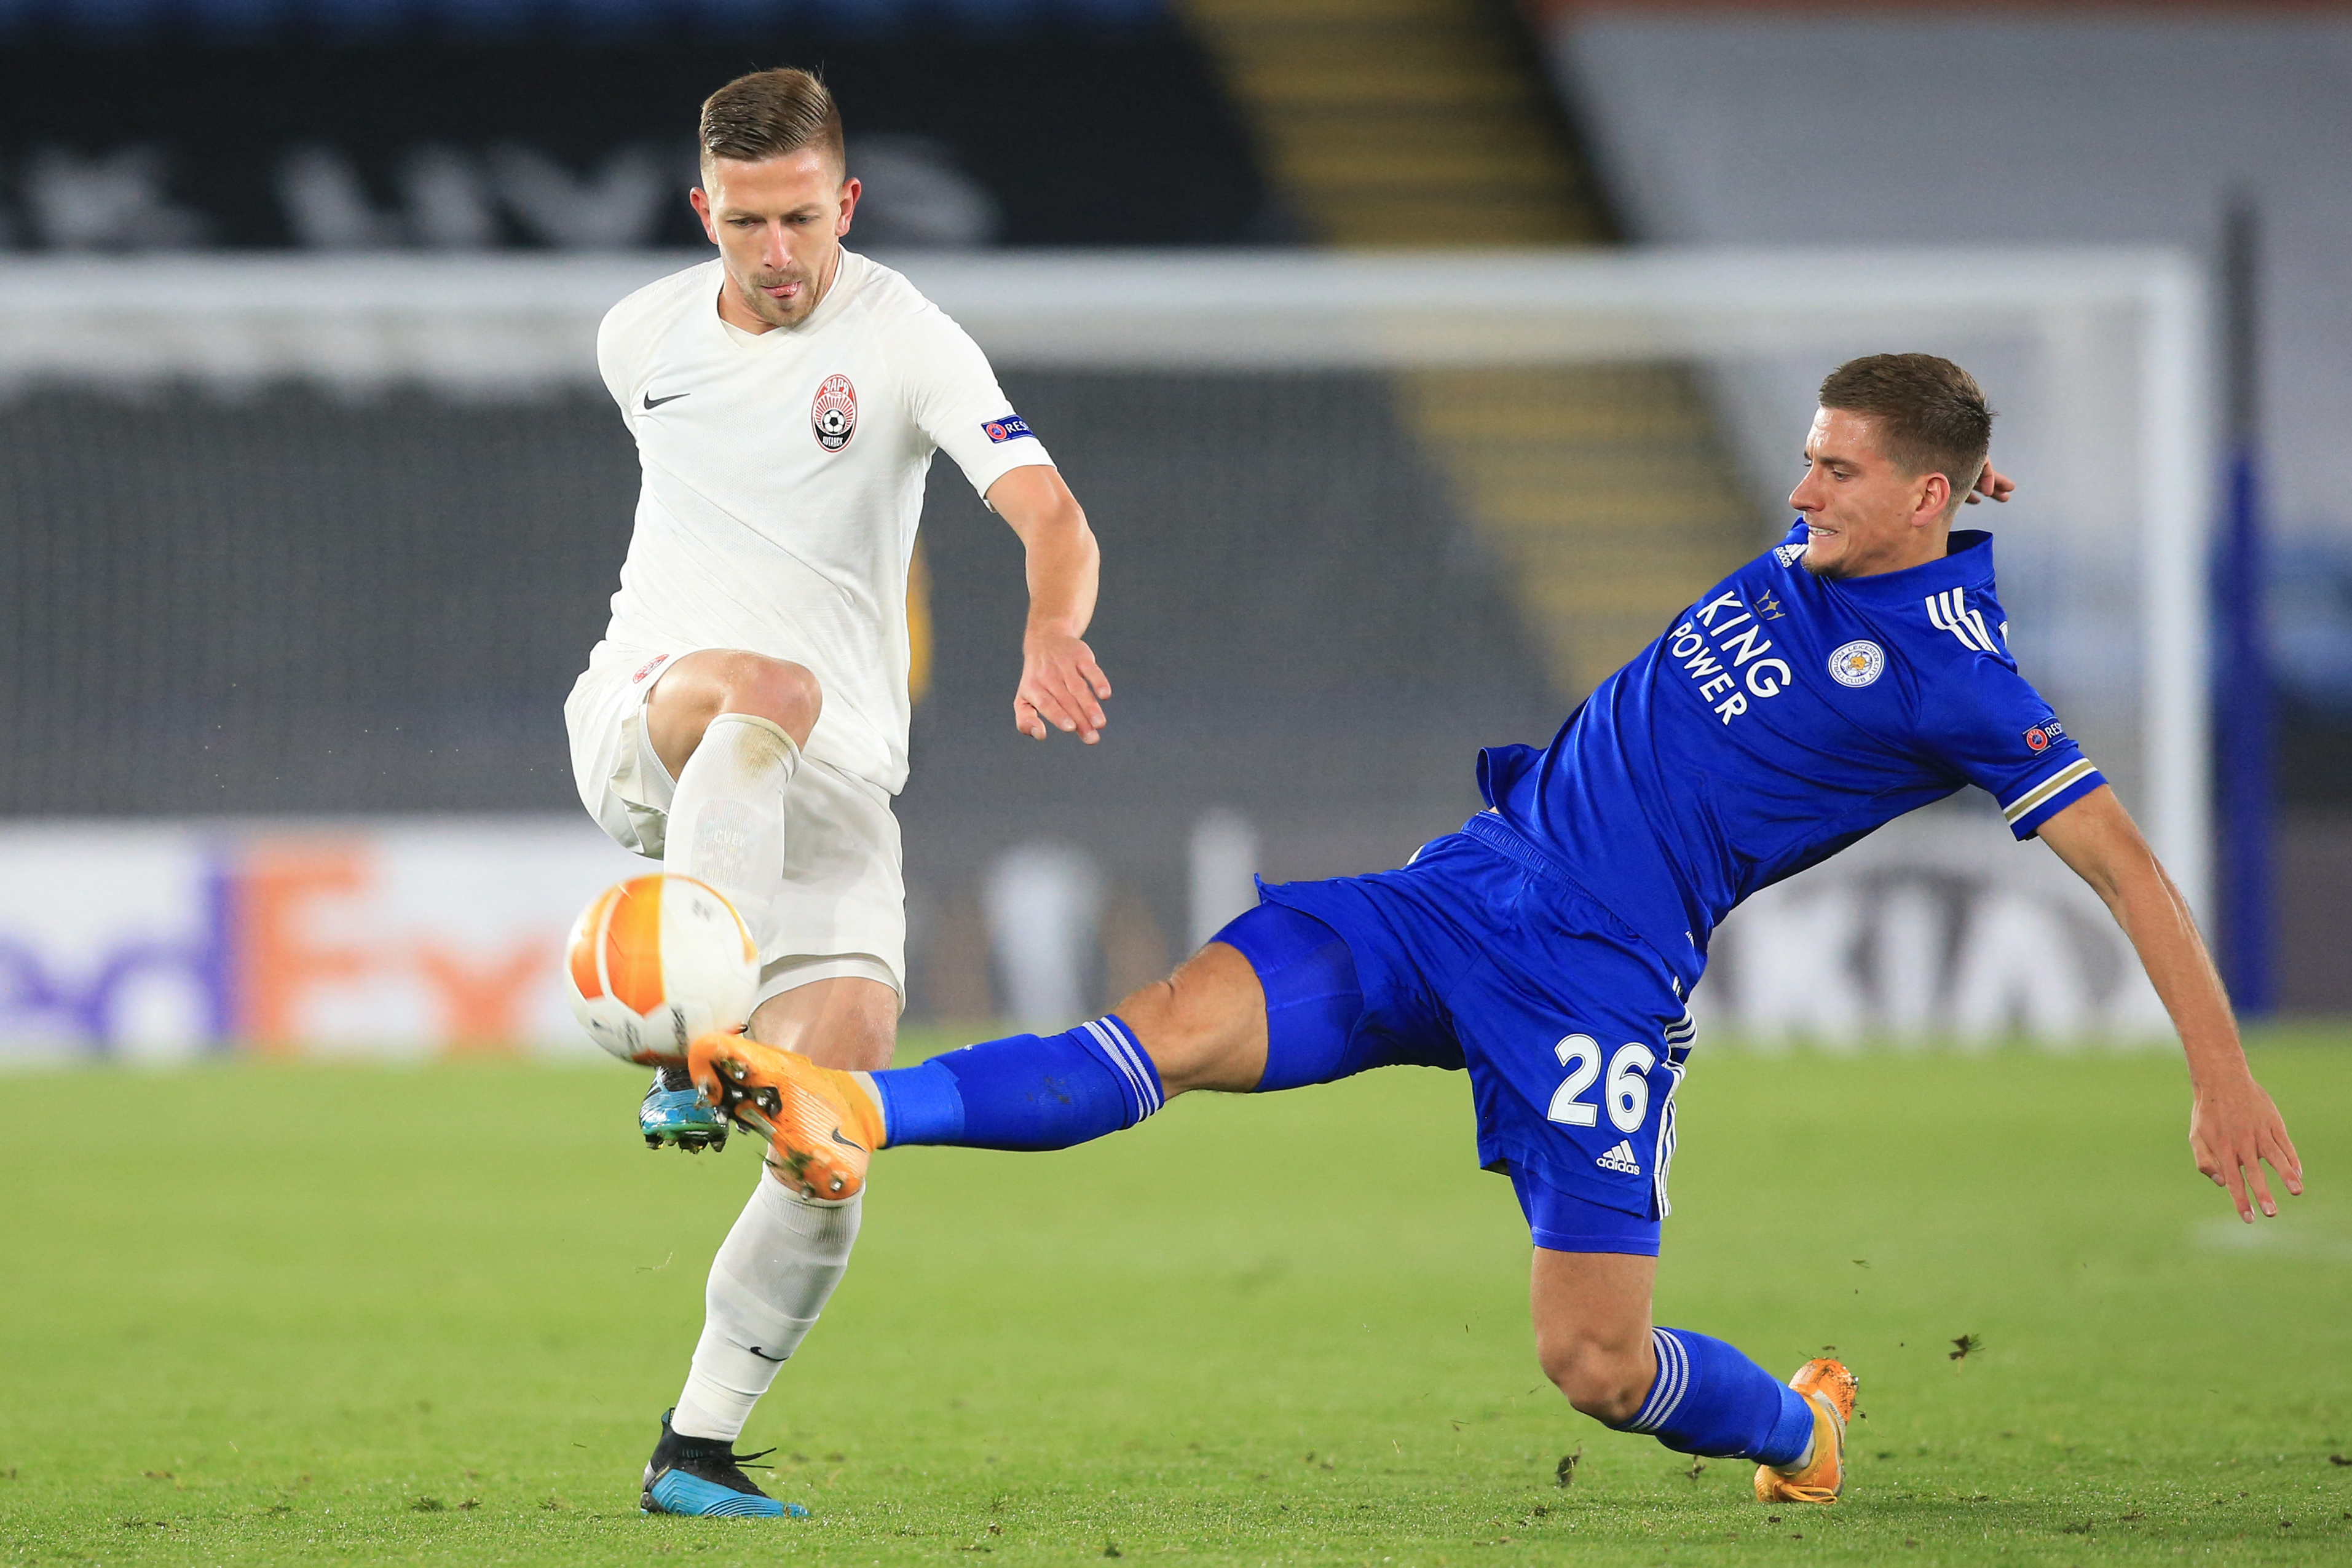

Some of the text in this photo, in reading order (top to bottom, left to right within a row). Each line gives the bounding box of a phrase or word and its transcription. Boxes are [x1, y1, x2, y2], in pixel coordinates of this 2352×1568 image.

[824, 378, 849, 396] ЗАРЯ
[1696, 590, 1792, 698] KING
[1667, 621, 1748, 726] POWER
[1833, 651, 1845, 680] FOOTBALL
[1847, 645, 1879, 678] LEICESTER CITY
[1547, 1033, 1656, 1133] 26
[1596, 1157, 1640, 1175] adidas
